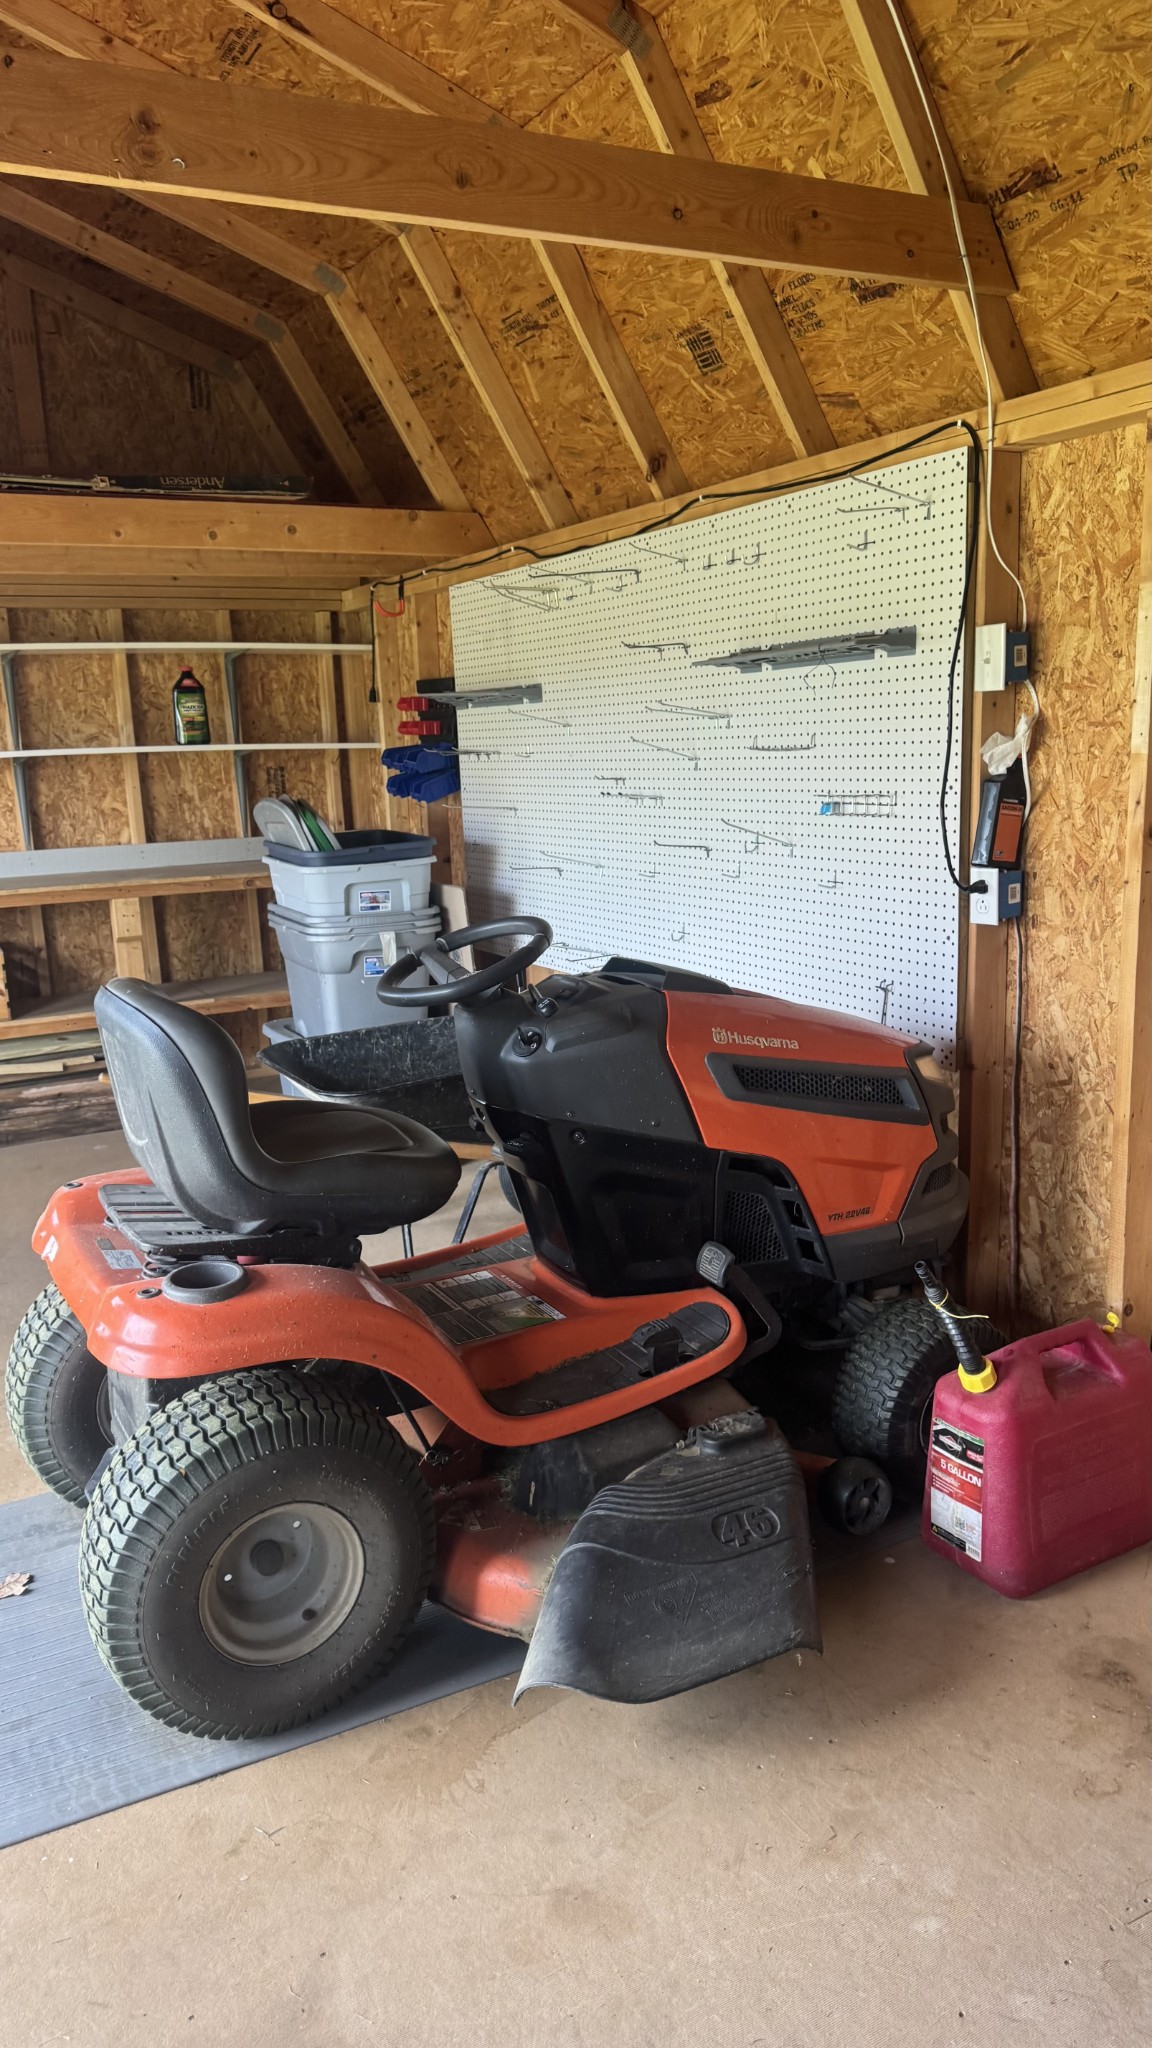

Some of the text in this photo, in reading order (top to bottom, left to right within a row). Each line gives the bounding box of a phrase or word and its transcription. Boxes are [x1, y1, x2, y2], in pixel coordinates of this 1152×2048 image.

[159, 476, 225, 489] Andersen
[727, 1030, 800, 1050] Husqvarna
[828, 1206, 870, 1222] YTH 22V46
[940, 1458, 947, 1470] 5
[947, 1463, 982, 1488] GALLON
[719, 1505, 777, 1548] 46
